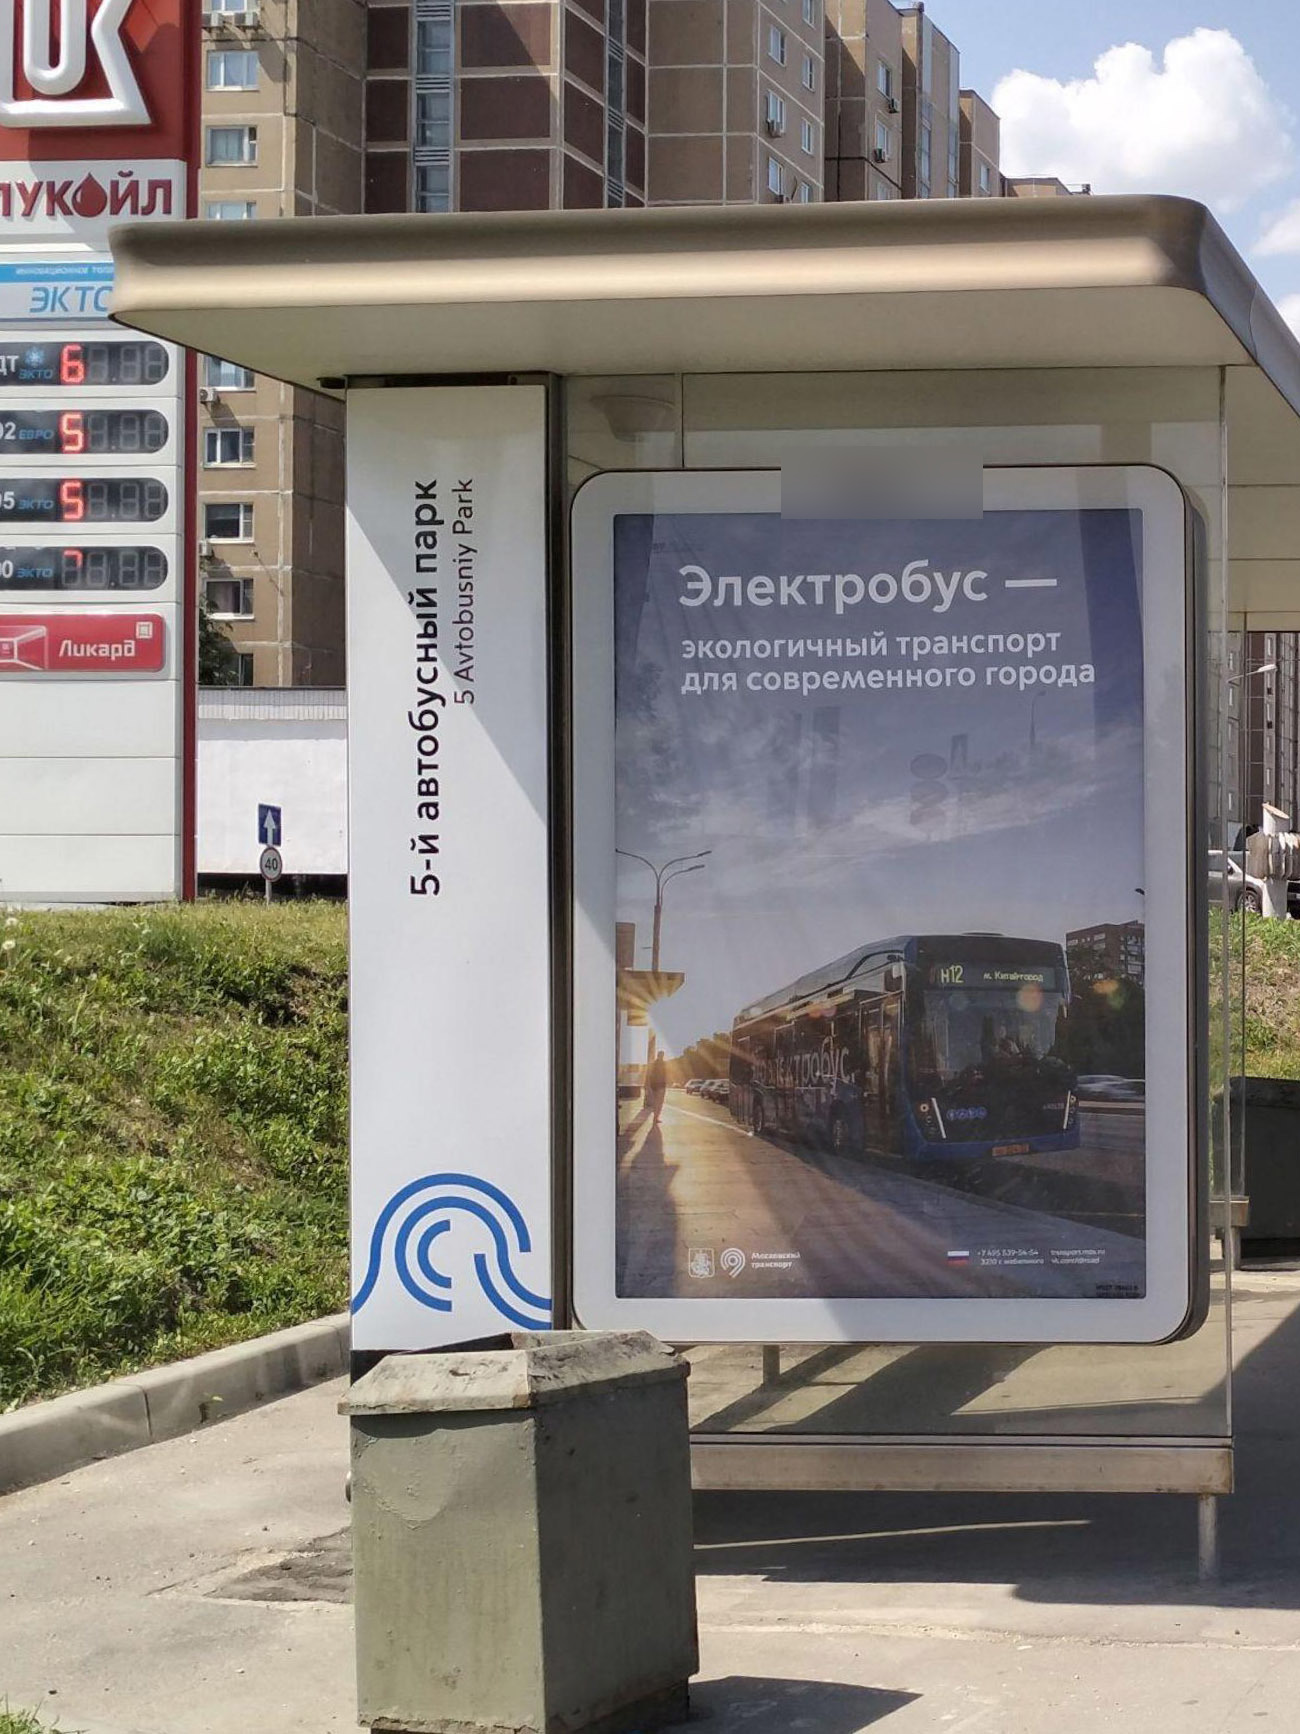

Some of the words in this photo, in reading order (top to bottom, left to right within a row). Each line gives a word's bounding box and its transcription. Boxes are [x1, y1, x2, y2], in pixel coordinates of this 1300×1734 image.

[18, 428, 54, 440] ЕВРО
[0, 491, 15, 510] 5
[18, 499, 54, 510] ЭКТО
[452, 479, 474, 534] Park
[414, 479, 445, 573] парк
[16, 567, 53, 578] ЭКТО
[678, 559, 989, 614] Электробус
[452, 543, 478, 683] Avtobusniy
[59, 639, 136, 660] Ликард
[680, 631, 888, 660] экологичный
[896, 630, 1062, 661] транспорт
[680, 670, 738, 695] для
[745, 665, 976, 696] современного
[985, 662, 1096, 691] города
[407, 587, 446, 820] автобусный
[453, 689, 475, 705] 5
[264, 857, 278, 871] 40
[410, 833, 440, 896] 5-й
